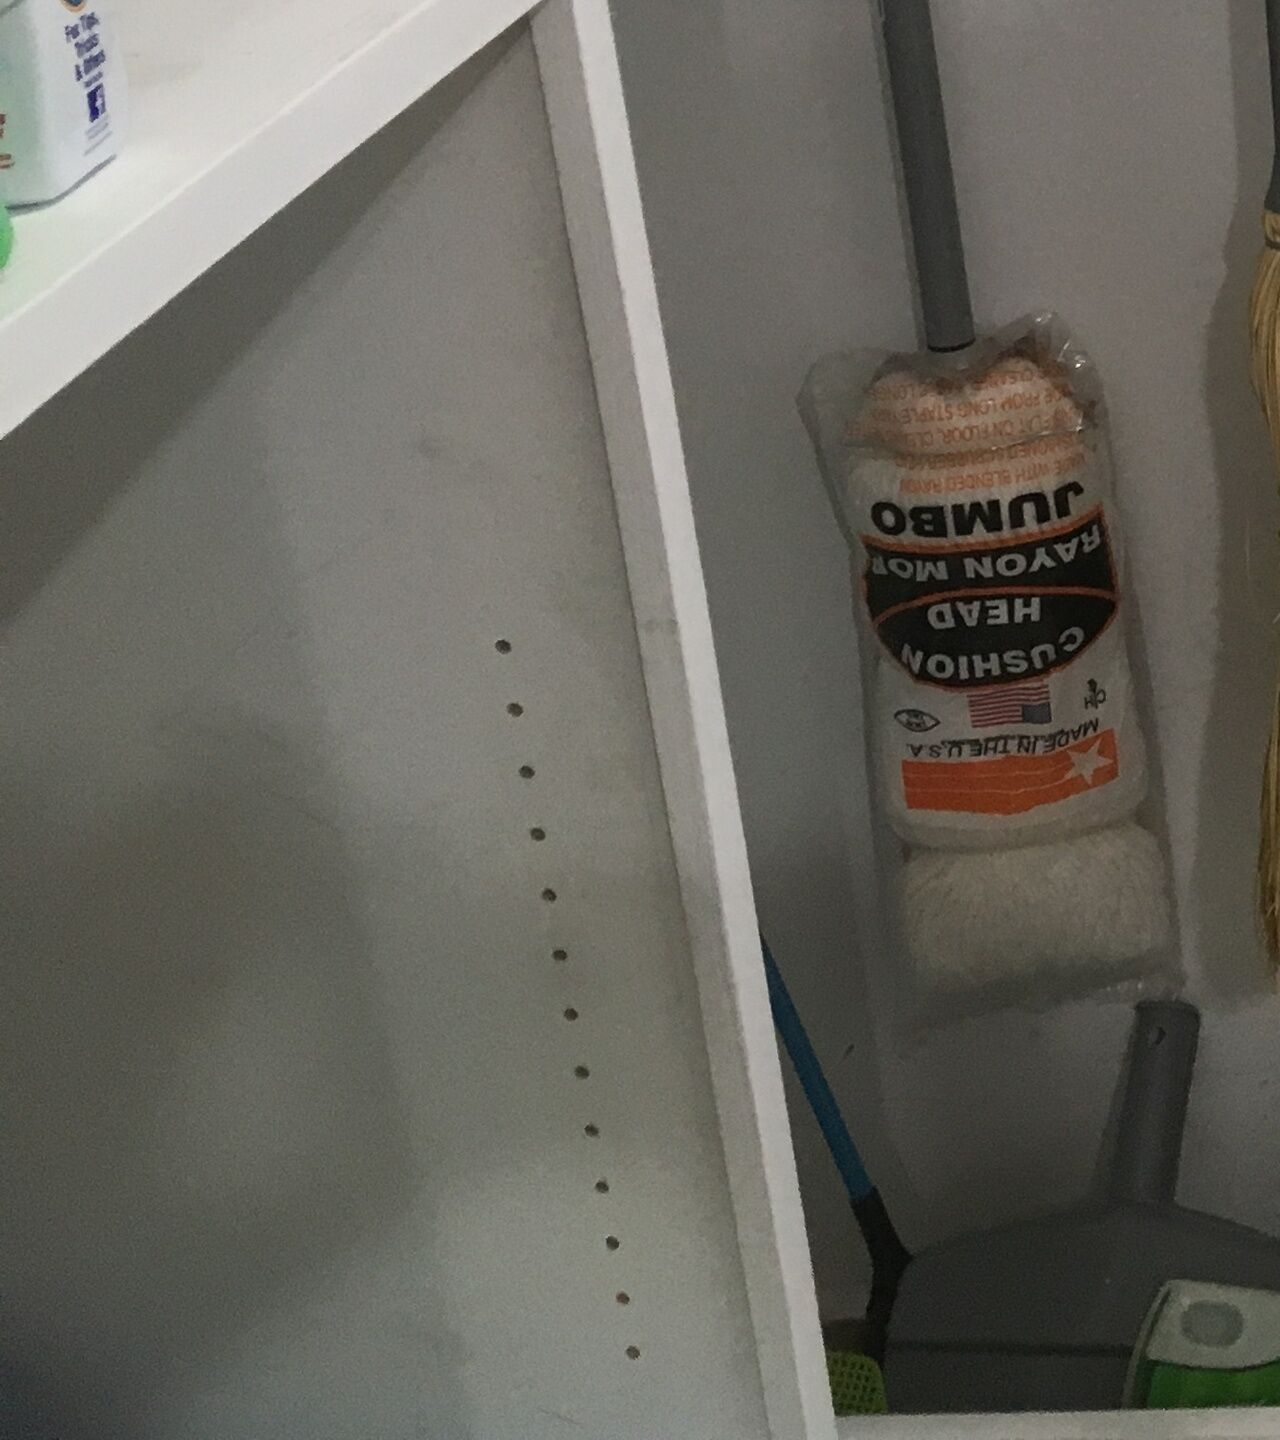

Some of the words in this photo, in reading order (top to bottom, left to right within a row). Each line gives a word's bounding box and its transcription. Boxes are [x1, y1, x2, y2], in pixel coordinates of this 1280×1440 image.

[957, 398, 997, 419] LONG
[1001, 391, 1040, 412] FROM
[899, 404, 953, 425] STAPLE
[992, 421, 1014, 439] ON
[948, 469, 1011, 490] BLENDED
[1015, 463, 1050, 484] WITH
[870, 481, 1084, 538] JUMBO
[963, 525, 1101, 578] RAYON
[927, 597, 1041, 630] HEAD
[902, 627, 1085, 680] CUSHION
[1016, 734, 1037, 755] IN
[1043, 718, 1099, 753] MADE
[970, 737, 1011, 758] THE
